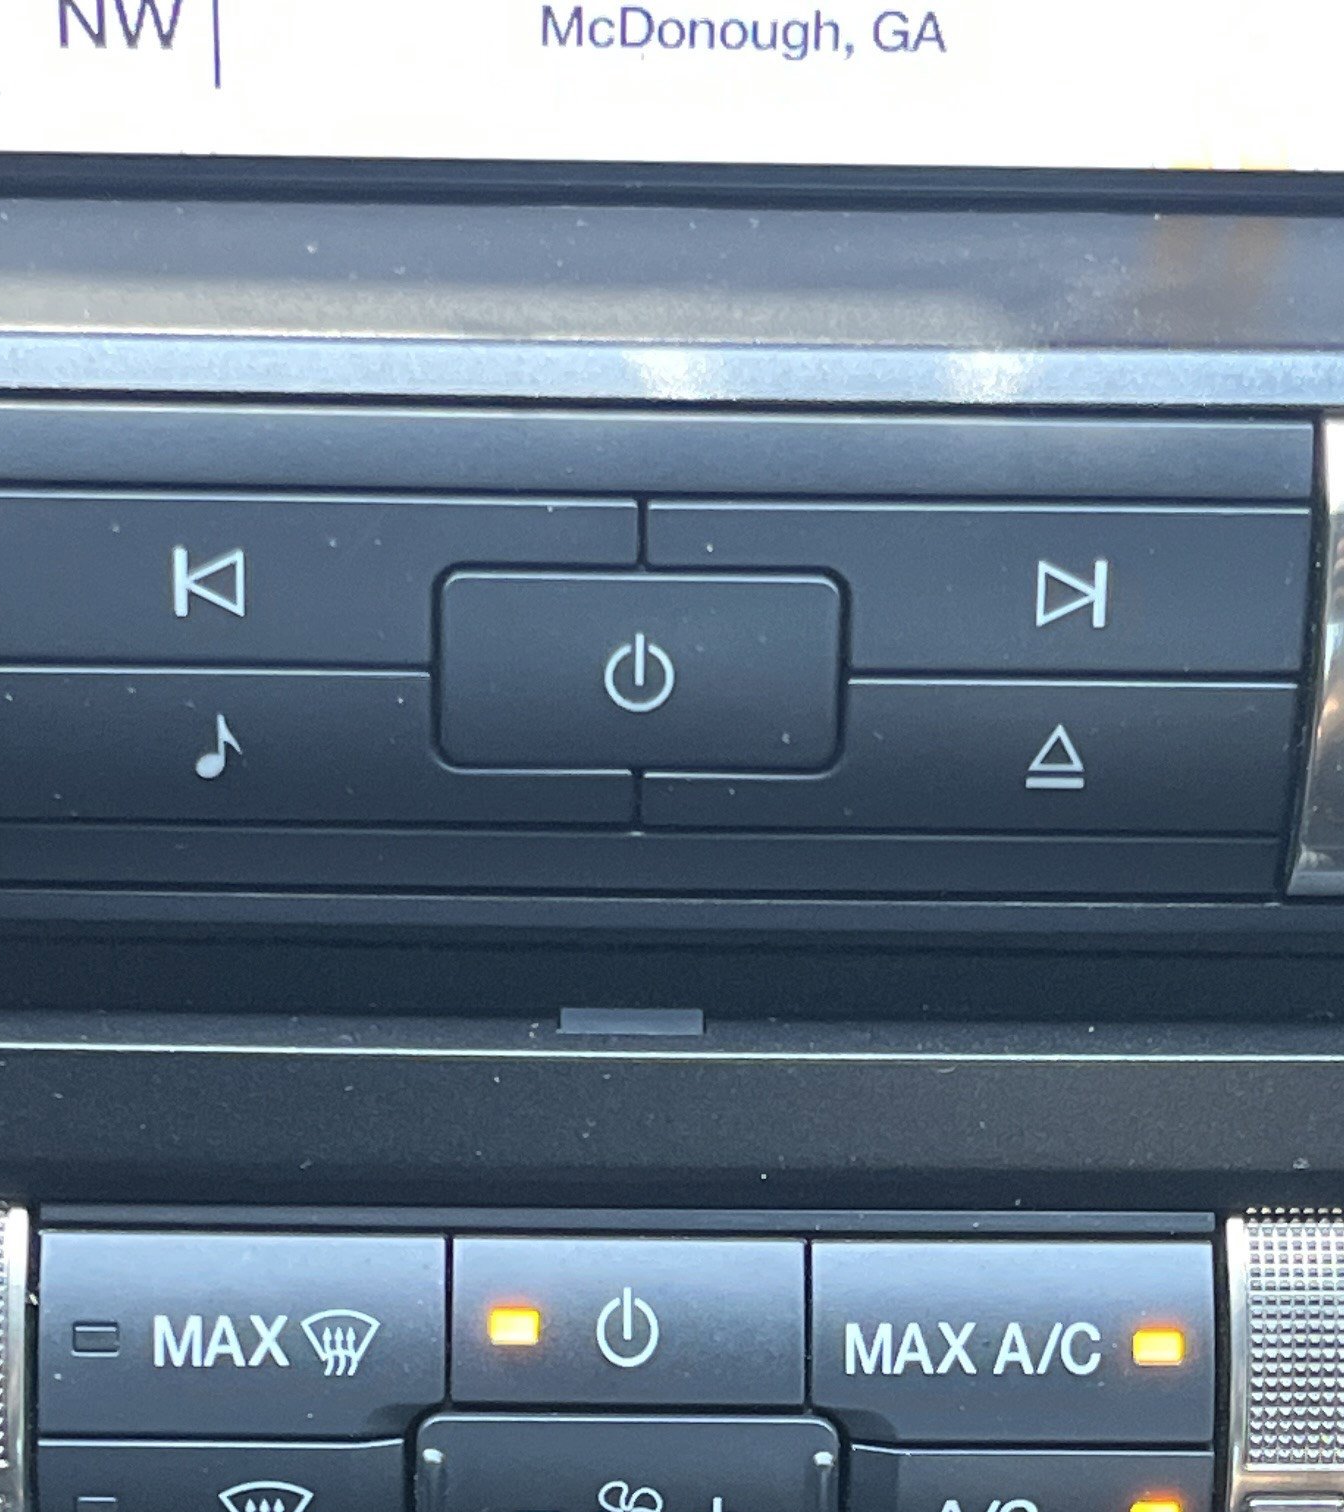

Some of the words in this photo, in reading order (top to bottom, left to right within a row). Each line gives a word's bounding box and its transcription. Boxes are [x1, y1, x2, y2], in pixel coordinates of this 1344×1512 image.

[58, 0, 184, 49] NW
[541, 5, 854, 60] McDonough,
[872, 11, 947, 53] GA
[151, 1314, 290, 1370] MAX
[843, 1322, 978, 1376] MAX
[992, 1322, 1103, 1376] A/C
